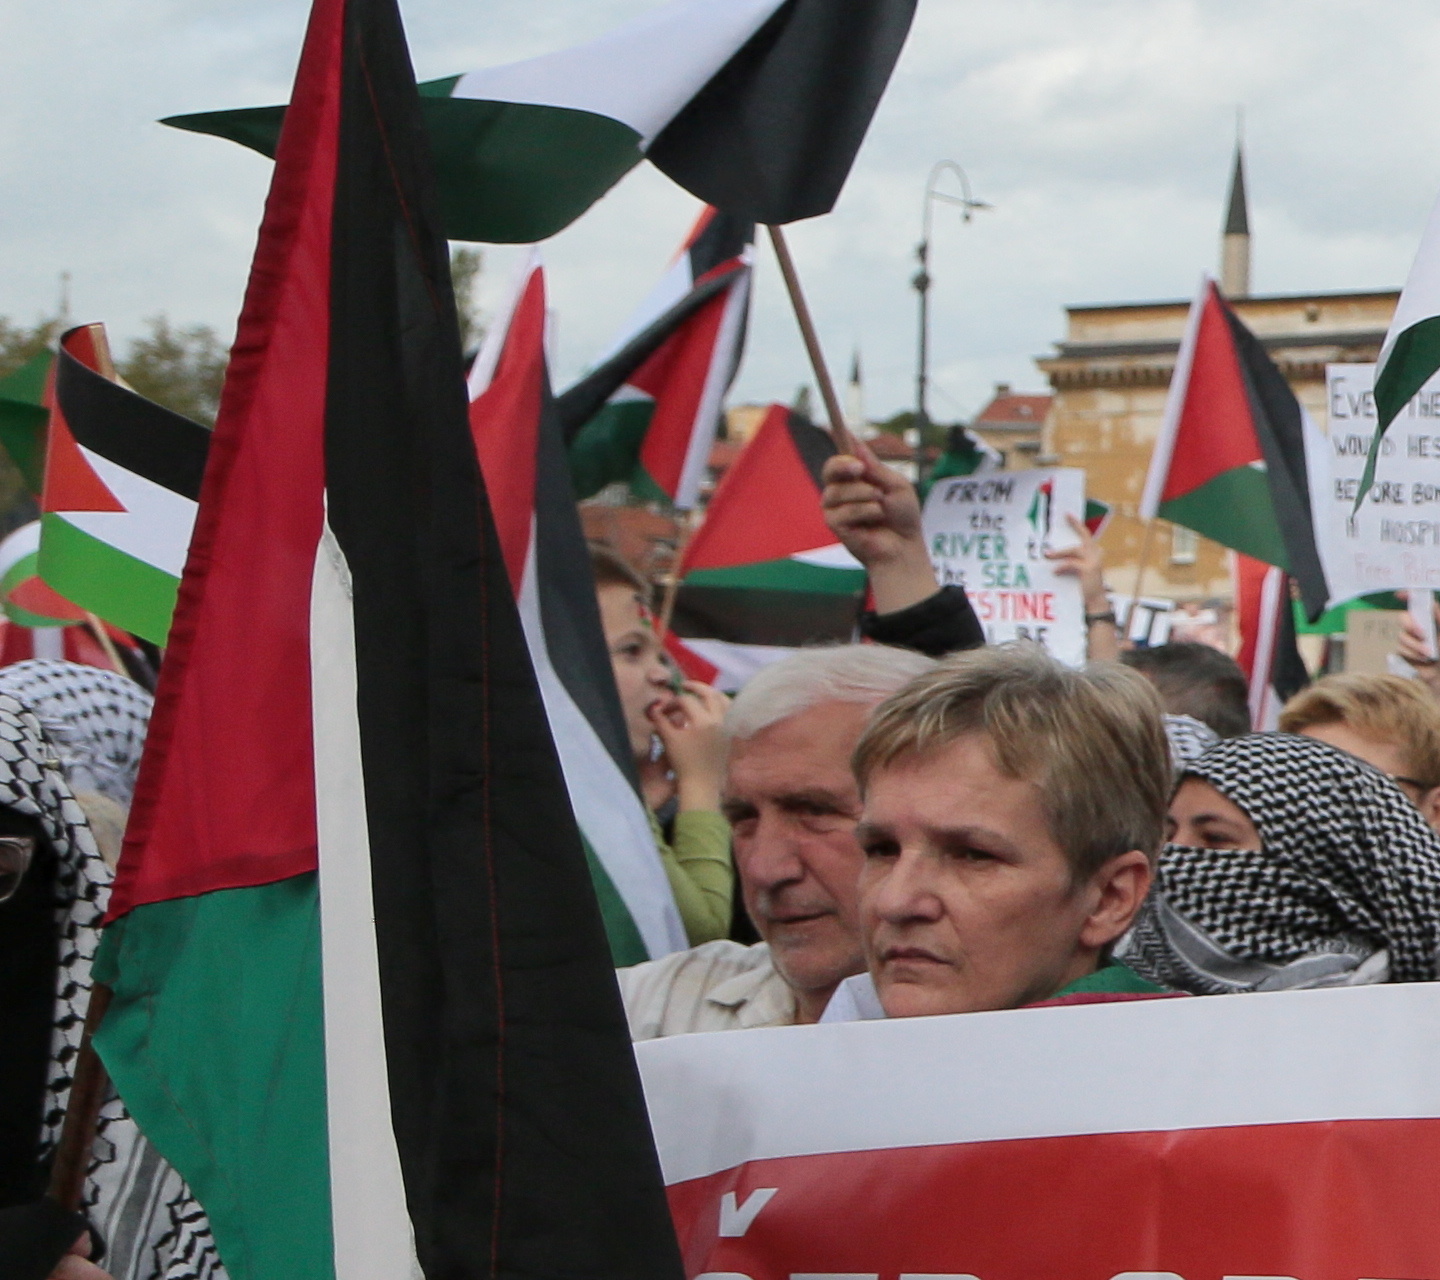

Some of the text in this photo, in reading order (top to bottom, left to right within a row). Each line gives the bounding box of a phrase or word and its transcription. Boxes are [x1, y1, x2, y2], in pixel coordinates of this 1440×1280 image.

[1330, 376, 1376, 418] EVE
[1332, 434, 1397, 457] WOUD
[944, 477, 1016, 504] FROM
[1334, 478, 1404, 504] BEORE
[970, 509, 1005, 531] the
[932, 532, 1008, 561] RIVER
[981, 561, 1031, 588] SEA
[964, 591, 1056, 621] STINE
